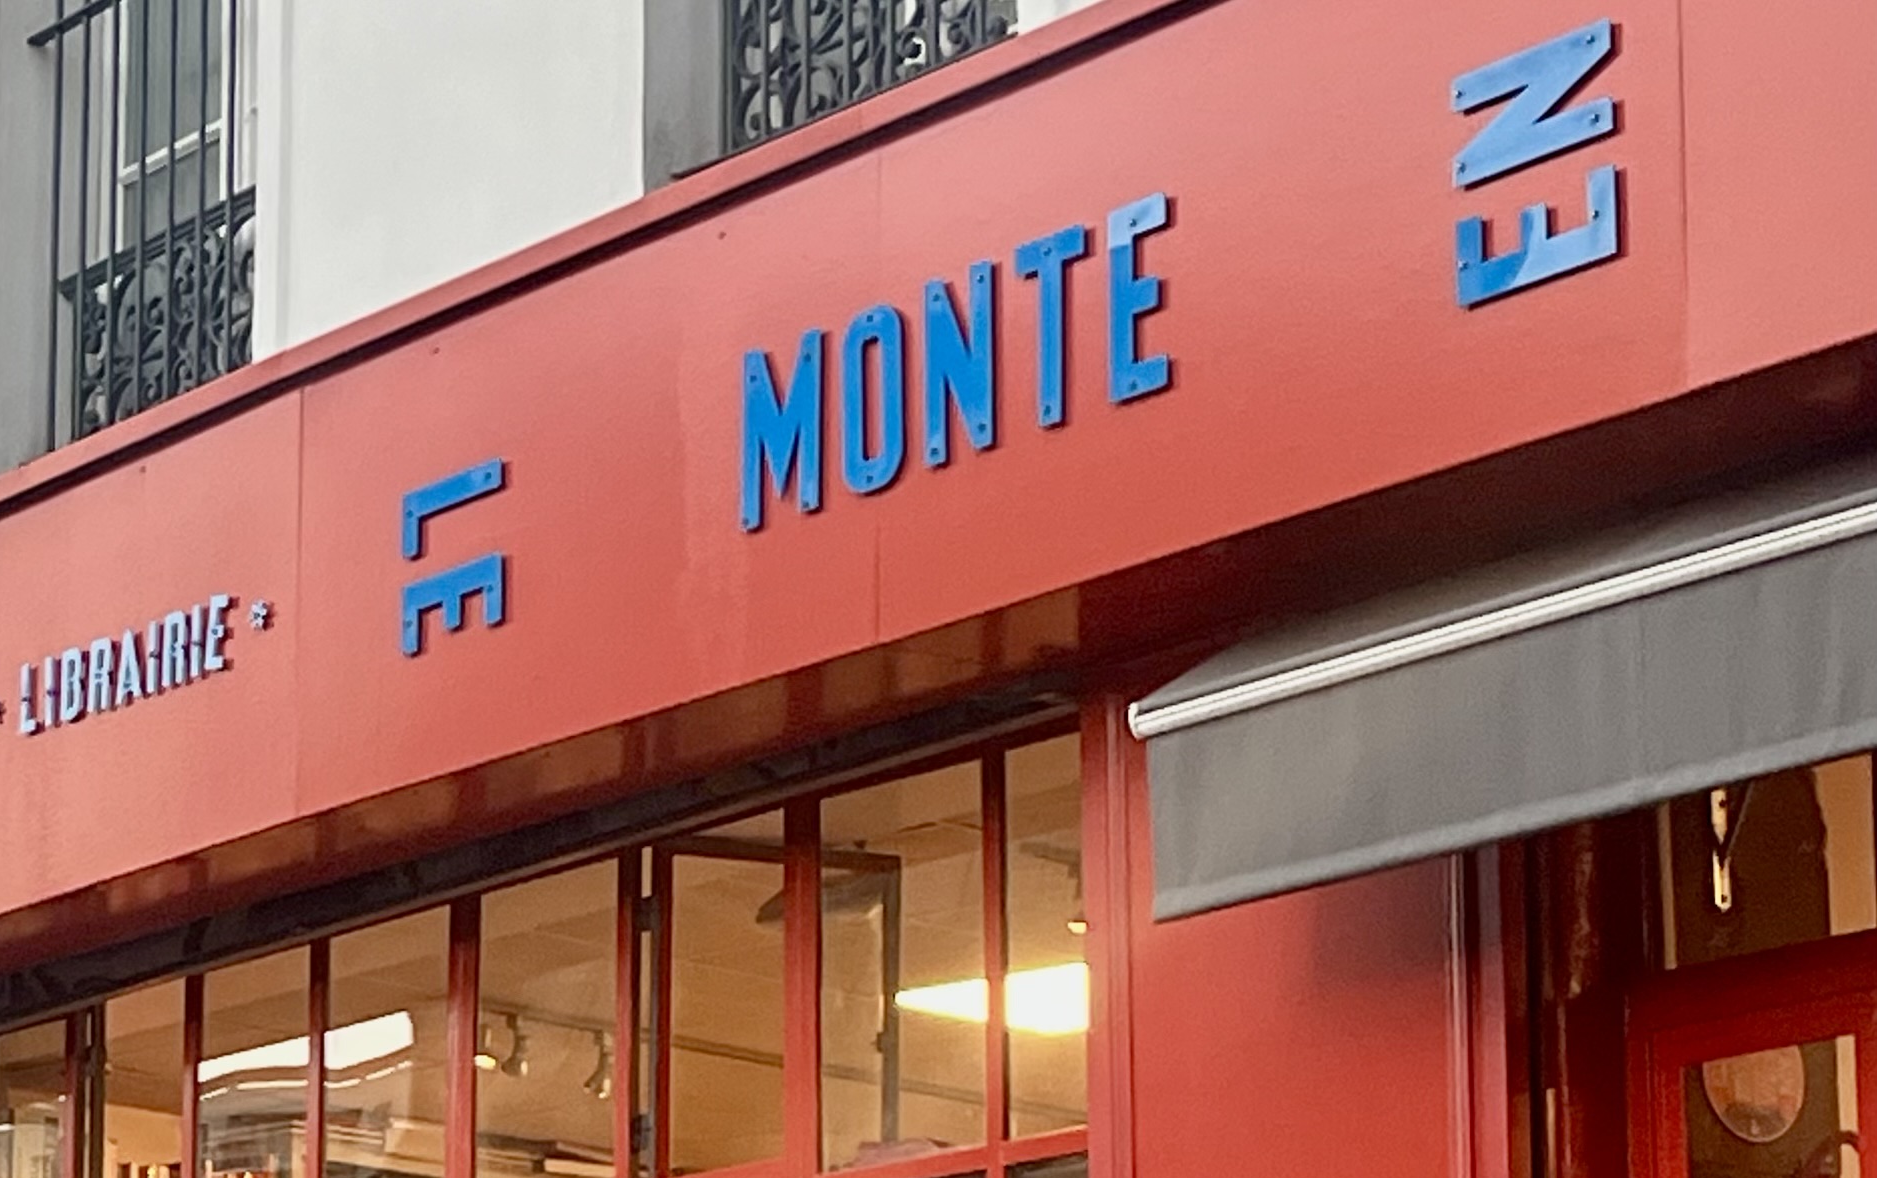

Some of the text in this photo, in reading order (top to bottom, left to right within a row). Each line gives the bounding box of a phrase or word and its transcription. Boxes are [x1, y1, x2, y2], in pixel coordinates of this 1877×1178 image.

[1451, 17, 1618, 309] EN
[739, 191, 1170, 534] MONTE
[17, 592, 231, 735] LIBRAIRIE
[401, 456, 506, 657] LE
